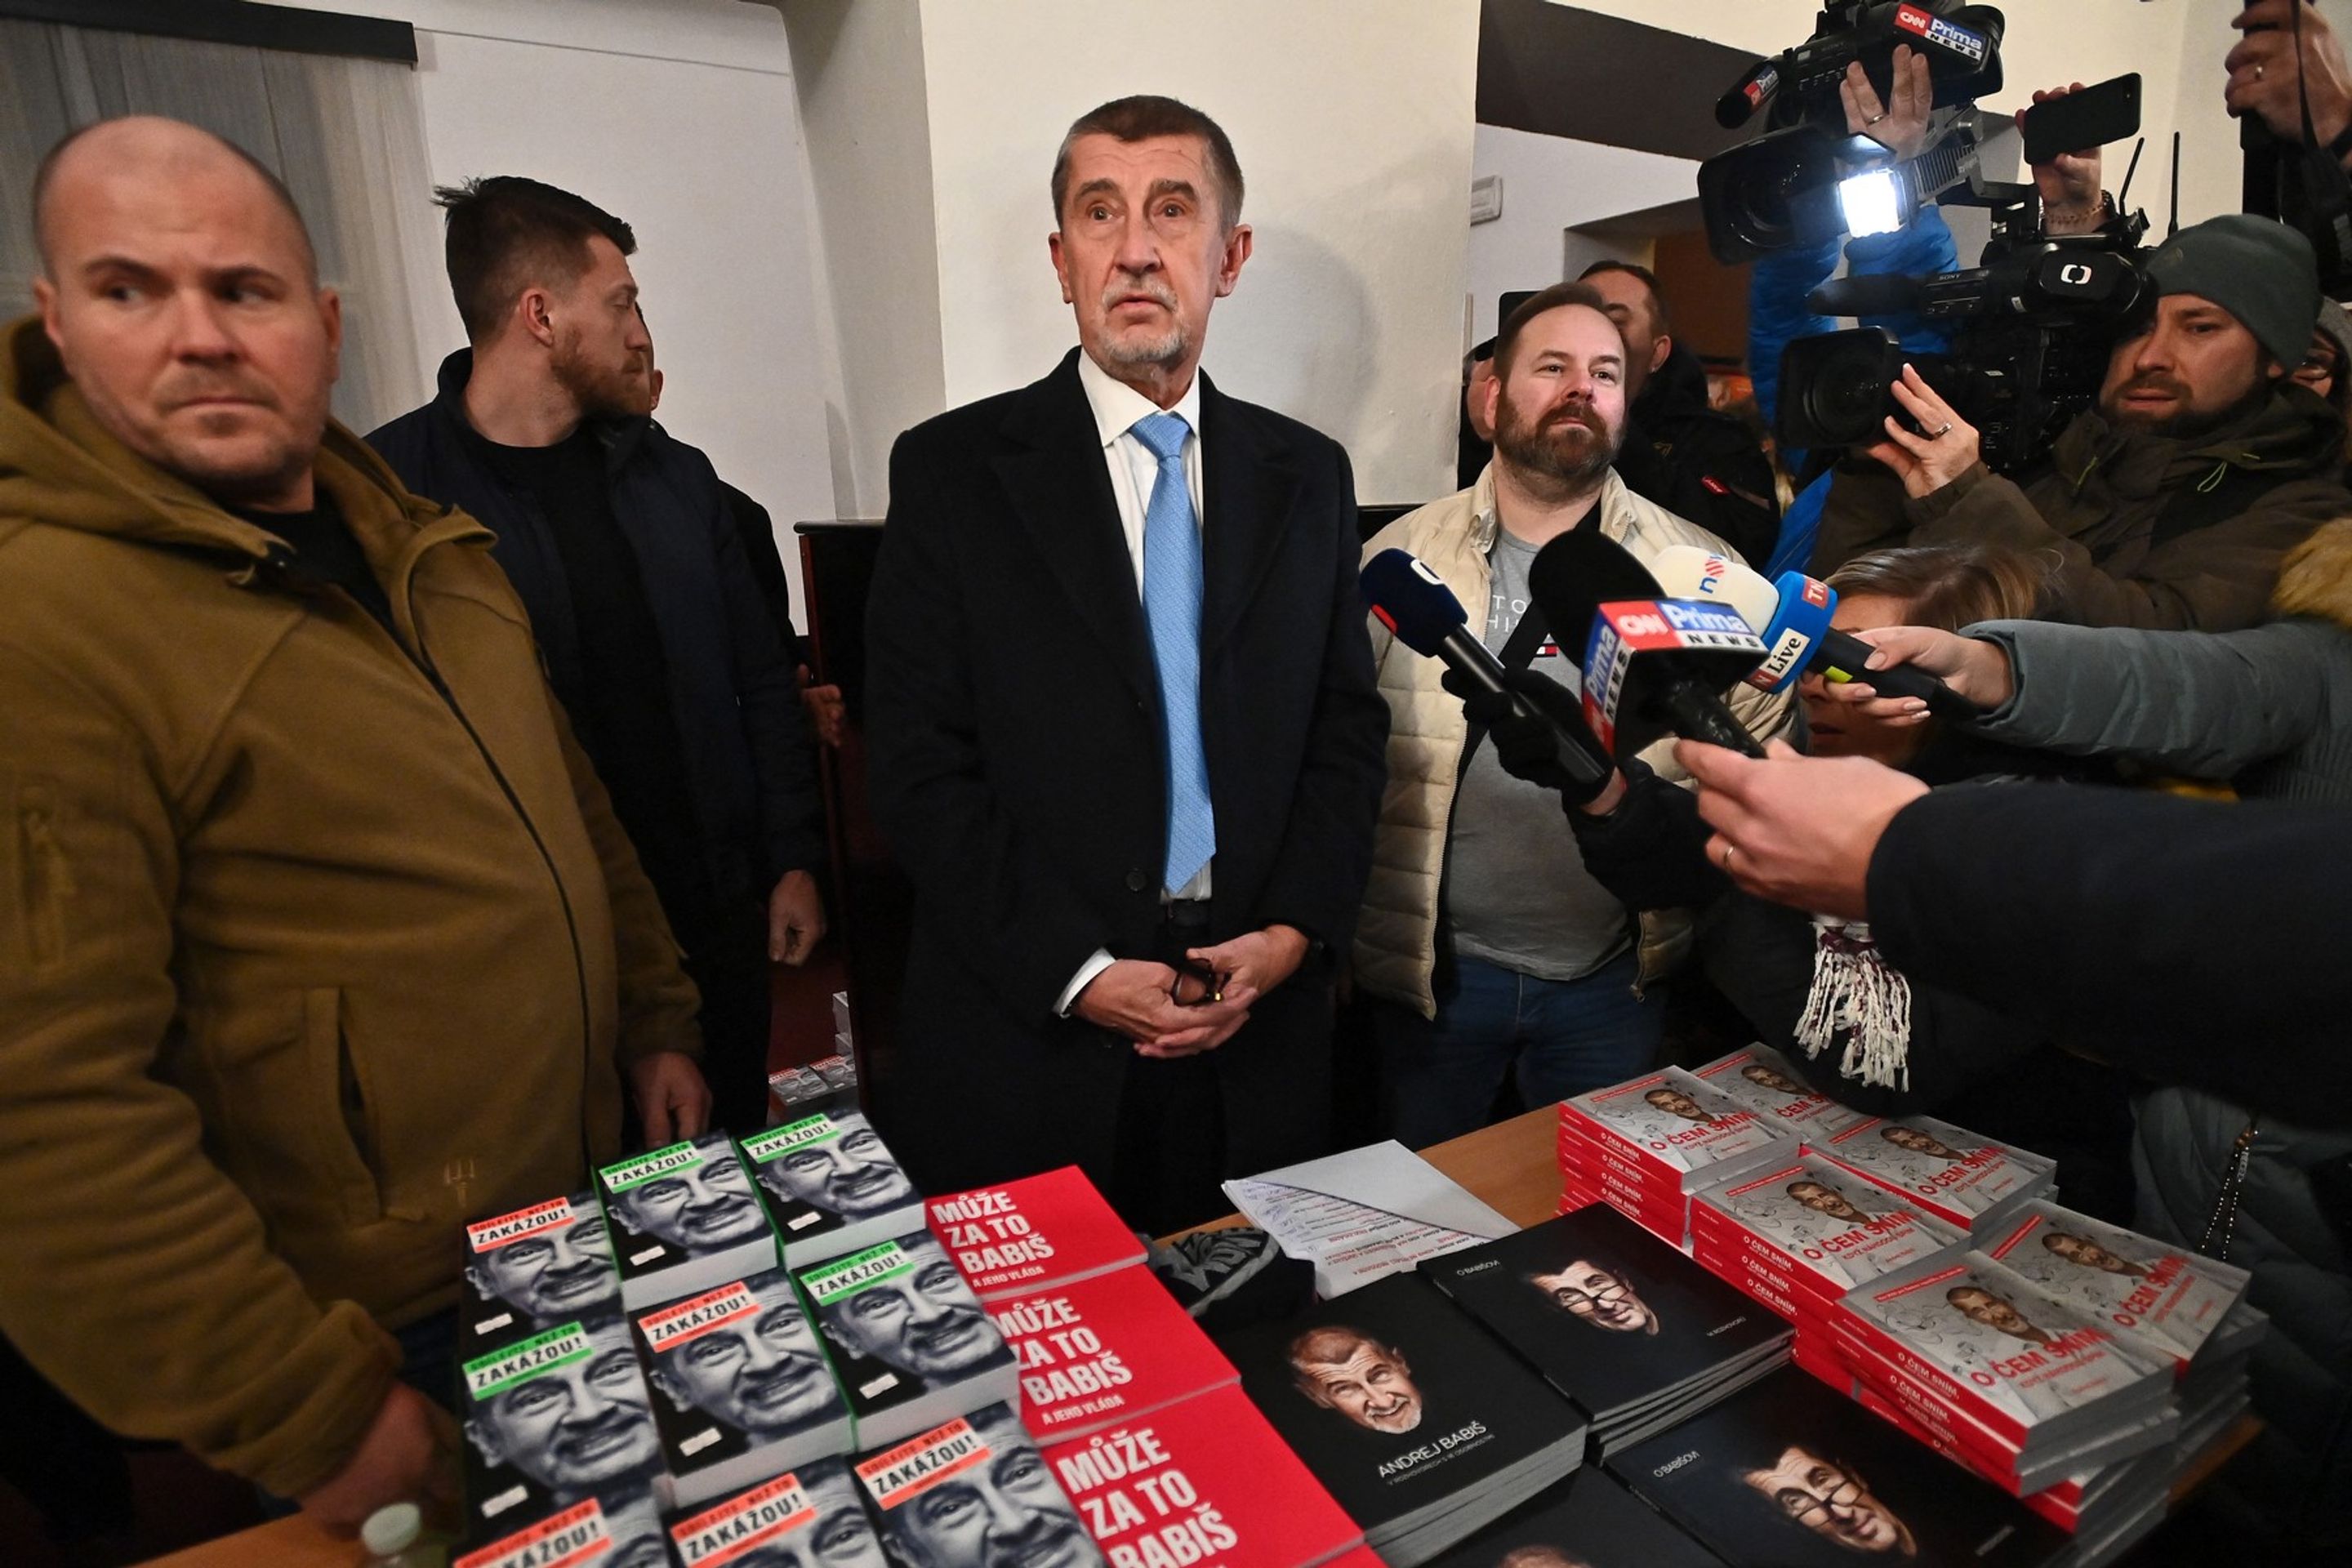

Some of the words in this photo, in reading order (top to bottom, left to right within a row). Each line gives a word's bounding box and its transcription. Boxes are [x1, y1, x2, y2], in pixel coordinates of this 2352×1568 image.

[1900, 11, 1926, 29] CNN
[1931, 18, 1982, 51] Prima
[1929, 33, 1981, 57] NEWS
[1659, 603, 1749, 632] Prima
[1688, 634, 1761, 648] NEWS
[1767, 637, 1802, 674] Live
[1585, 624, 1617, 706] Prima
[1605, 649, 1628, 722] NEWS
[1775, 1098, 1814, 1118] ČEM
[754, 1124, 831, 1156] ZAKÁŽOU!
[1650, 1141, 1667, 1151] O
[1668, 1124, 1705, 1145] ČEM
[612, 1151, 695, 1185] ZAKÁŽOU!
[1918, 1183, 1938, 1196] O
[1931, 1165, 1970, 1187] ČEM
[931, 1192, 1017, 1224] MŮŽE
[477, 1208, 568, 1244] ZAKÁŽOU!
[943, 1223, 990, 1248] ZA
[986, 1214, 1031, 1239] TO
[958, 1233, 1055, 1274] BABIŠ
[1751, 1239, 1770, 1256] ČEM
[1803, 1248, 1824, 1260] O
[1819, 1230, 1869, 1254] ČEM
[815, 1254, 905, 1296] ZAKÁŽOU!
[982, 1273, 1009, 1286] JEHO
[1008, 1266, 1045, 1281] VLÁDA
[1749, 1259, 1768, 1276] ČEM
[1755, 1282, 1774, 1299] ČEM
[2118, 1285, 2163, 1316] ČEM
[652, 1295, 749, 1341] ZAKÁŽOU!
[991, 1298, 1082, 1338] MŮŽE
[2112, 1312, 2138, 1328] O
[1048, 1327, 1102, 1360] TO
[475, 1337, 583, 1387] ZAKÁŽOU!
[1022, 1350, 1133, 1406] BABIŠ
[1907, 1357, 1930, 1379] ČEM
[1971, 1371, 1997, 1387] O
[1988, 1351, 2049, 1379] ČEM
[1041, 1413, 1054, 1425] A
[1053, 1405, 1084, 1423] JEHO
[1082, 1394, 1125, 1414] VLÁDA
[874, 1435, 978, 1494] ZAKÁŽOU!
[1057, 1428, 1171, 1494] MŮŽE
[1378, 1442, 1441, 1478] ANDREJ
[1438, 1419, 1487, 1451] BABIŠ
[1653, 1468, 1664, 1477] O
[1080, 1490, 1146, 1540] ZA
[1134, 1469, 1197, 1516] TO
[686, 1493, 804, 1559] ZAKÁŽOU!
[1107, 1502, 1239, 1568] BABIŠ
